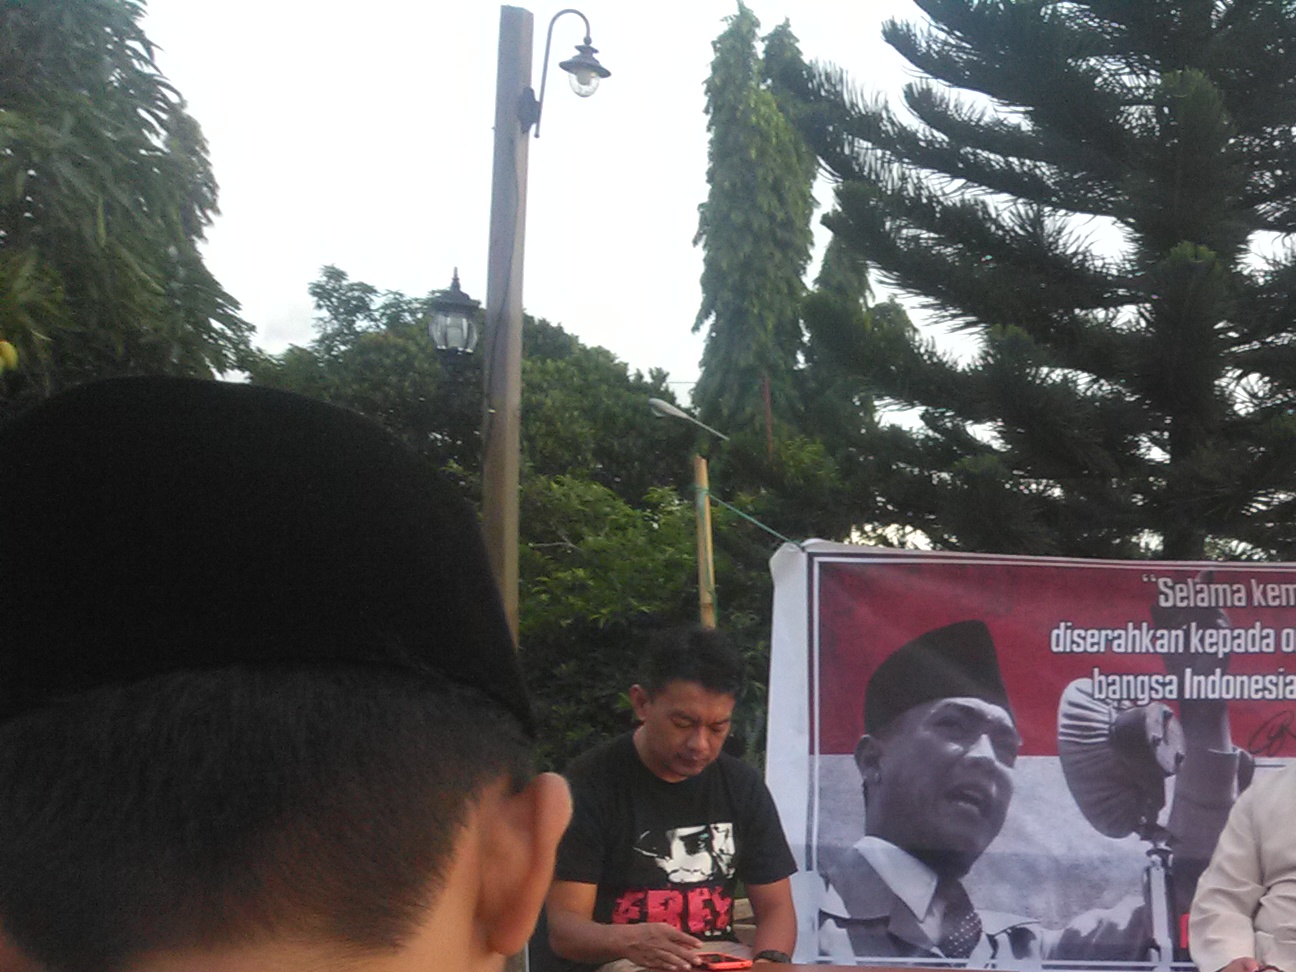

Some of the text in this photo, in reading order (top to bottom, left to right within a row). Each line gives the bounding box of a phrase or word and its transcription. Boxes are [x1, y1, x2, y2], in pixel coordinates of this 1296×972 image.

[1051, 621, 1185, 654] diserahkan
[1190, 622, 1275, 658] kepada
[1093, 667, 1178, 706] bangsa
